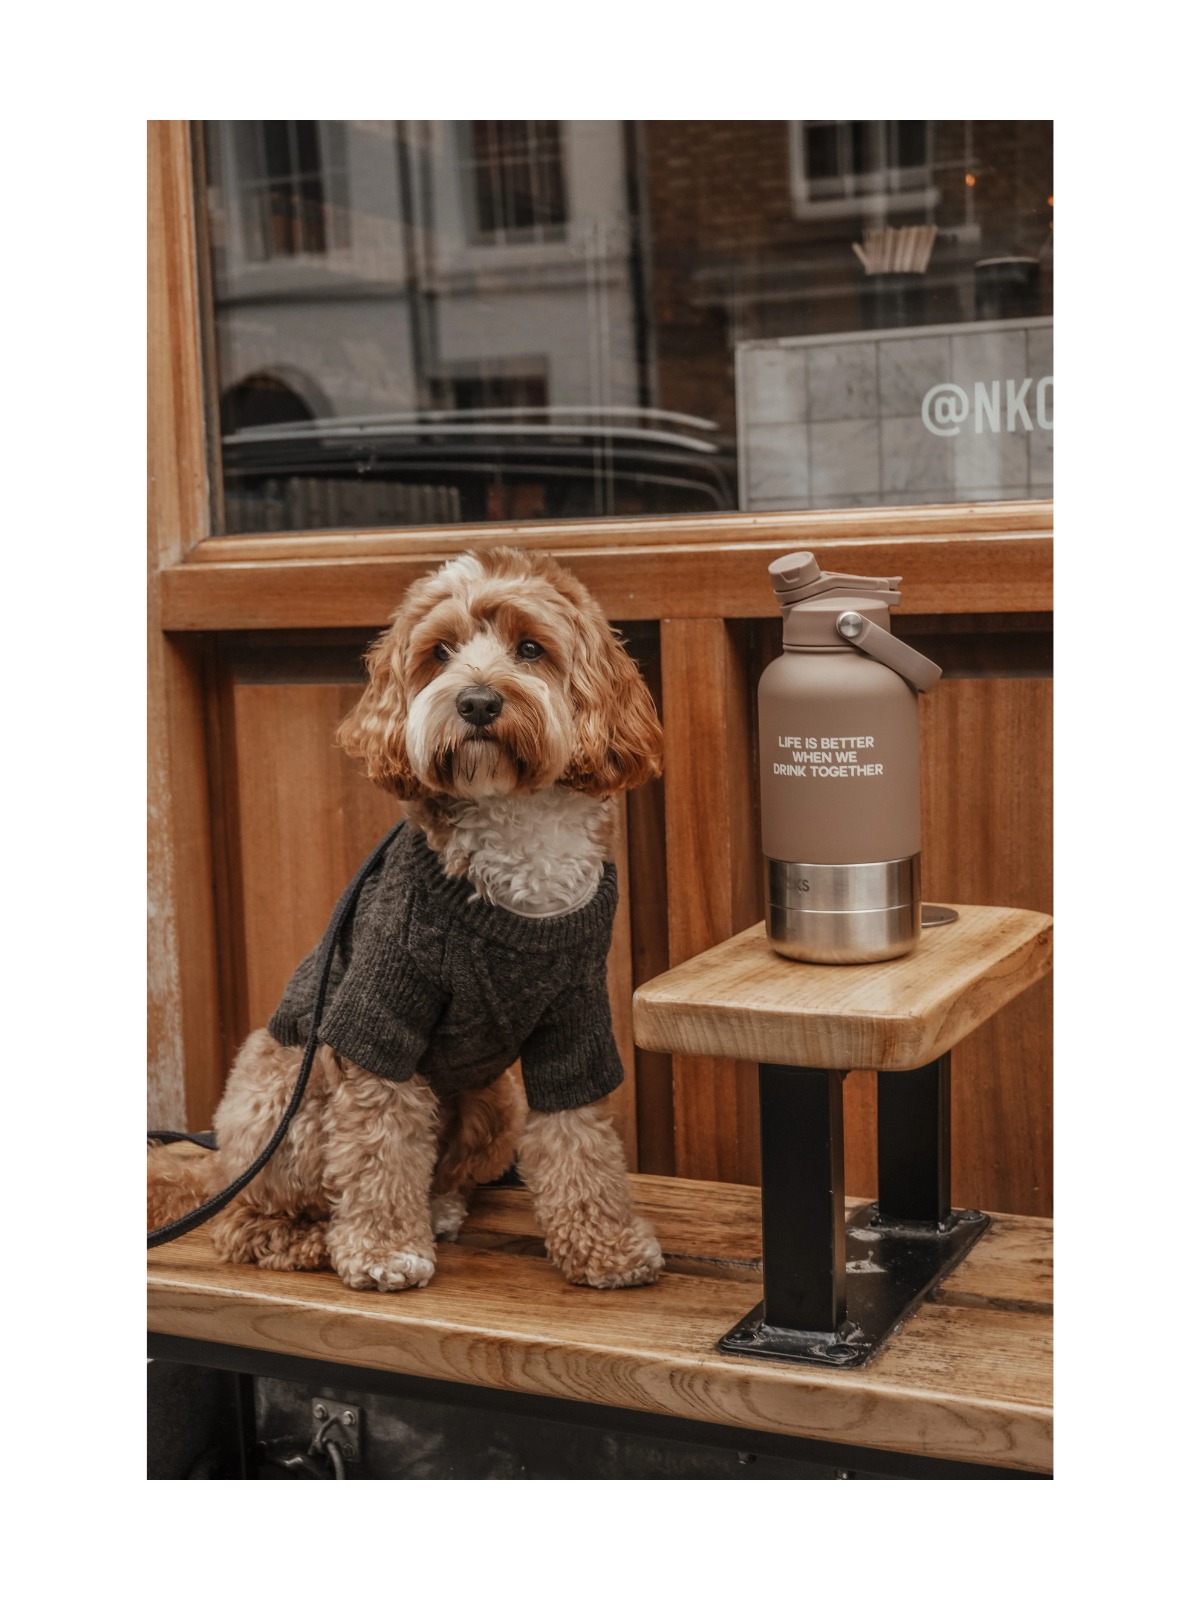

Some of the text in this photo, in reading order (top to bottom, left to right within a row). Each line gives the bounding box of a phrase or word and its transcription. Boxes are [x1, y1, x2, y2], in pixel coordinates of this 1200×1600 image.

[778, 735, 875, 749] LIFE IS BETTER
[792, 751, 858, 763] WHEN WE
[773, 763, 884, 777] DRINK TOGETHER
